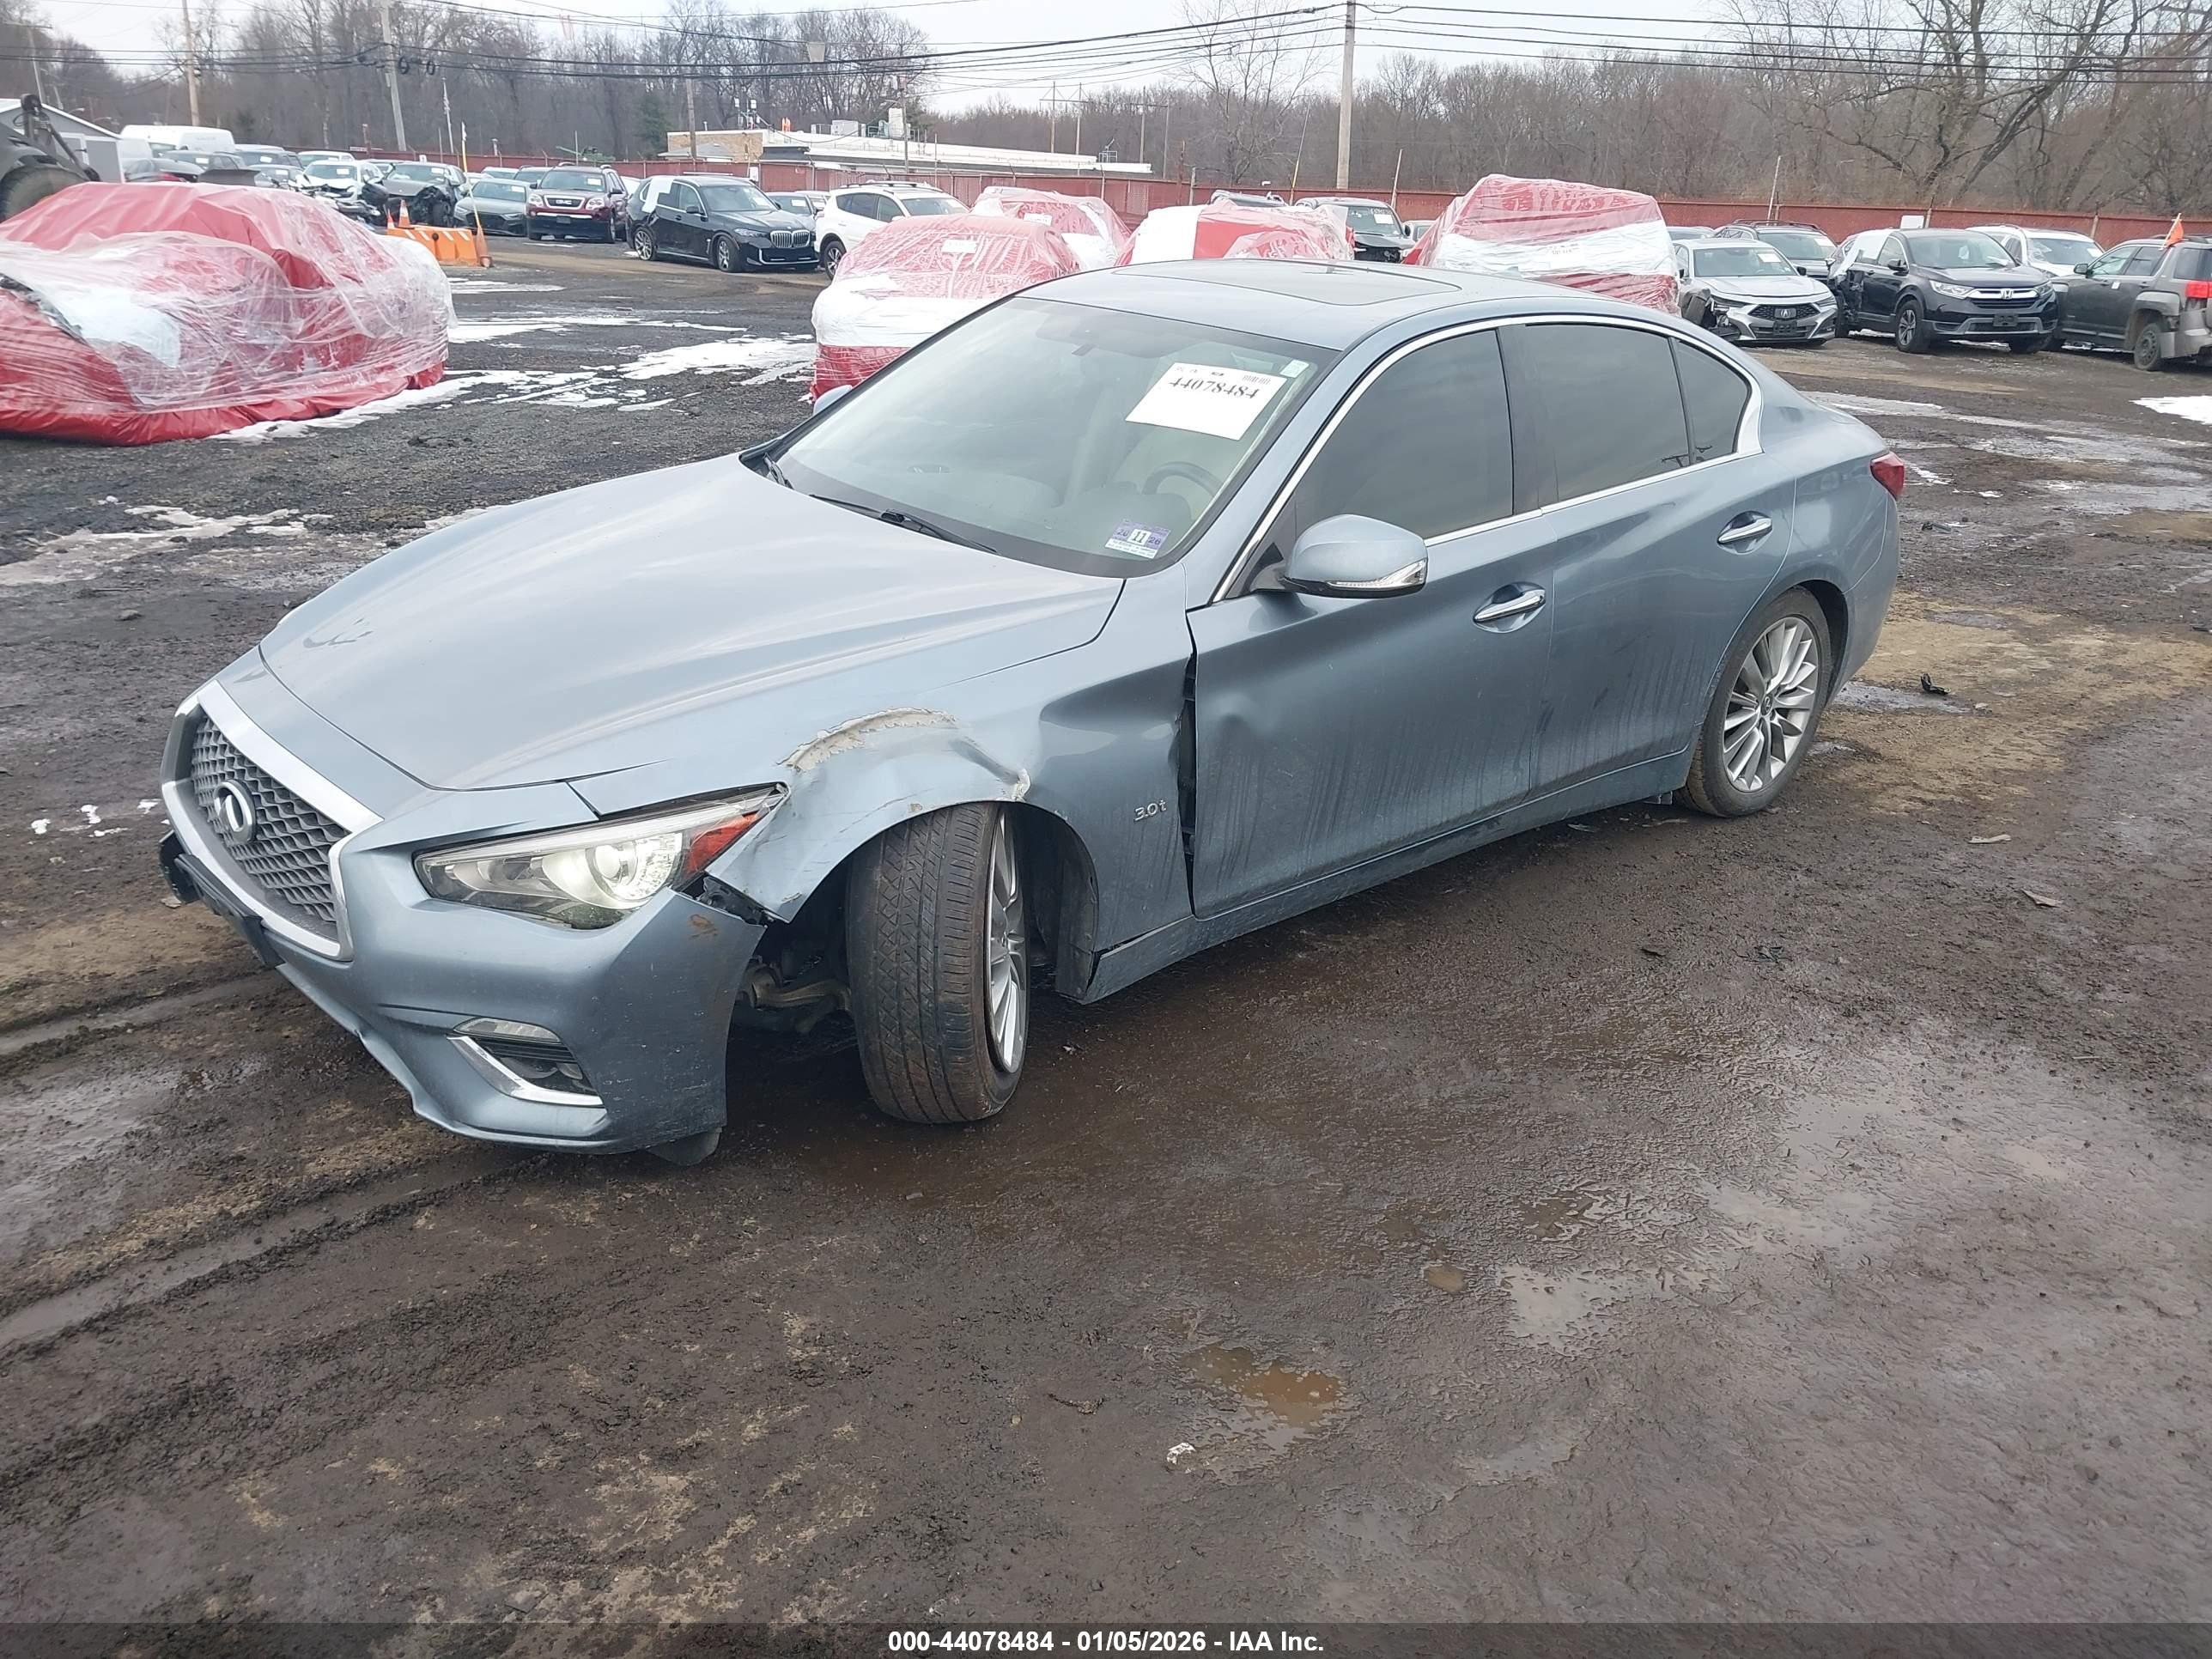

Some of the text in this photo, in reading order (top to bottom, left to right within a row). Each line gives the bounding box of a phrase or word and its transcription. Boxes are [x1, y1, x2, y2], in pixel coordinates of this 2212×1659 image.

[1169, 377, 1260, 398] 44078484
[1132, 531, 1147, 544] 11
[1147, 537, 1161, 545] 26
[1134, 799, 1167, 821] 3.0t
